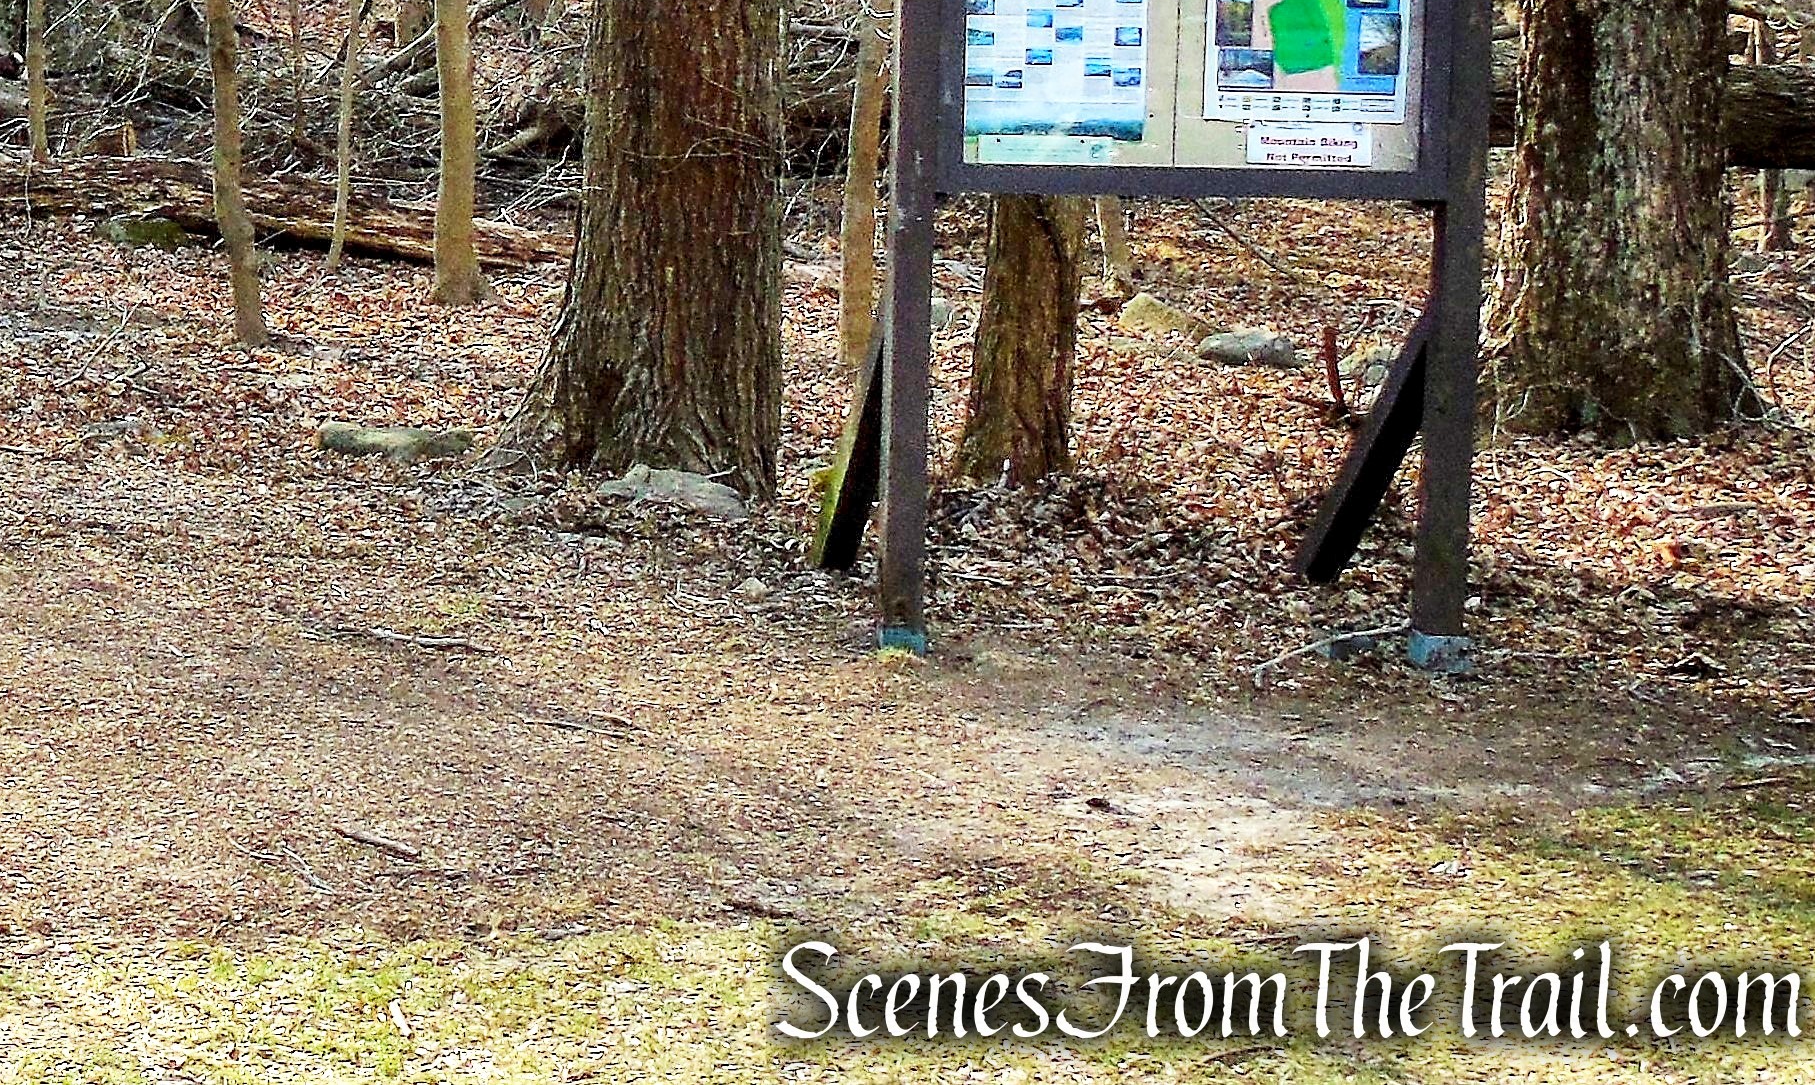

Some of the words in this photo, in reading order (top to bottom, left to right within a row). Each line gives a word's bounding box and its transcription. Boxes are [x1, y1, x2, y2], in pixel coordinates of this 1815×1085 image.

[1260, 136, 1317, 146] Mountain
[1320, 137, 1358, 149] Biking
[1266, 153, 1287, 162] Not
[1291, 153, 1352, 163] Permitted
